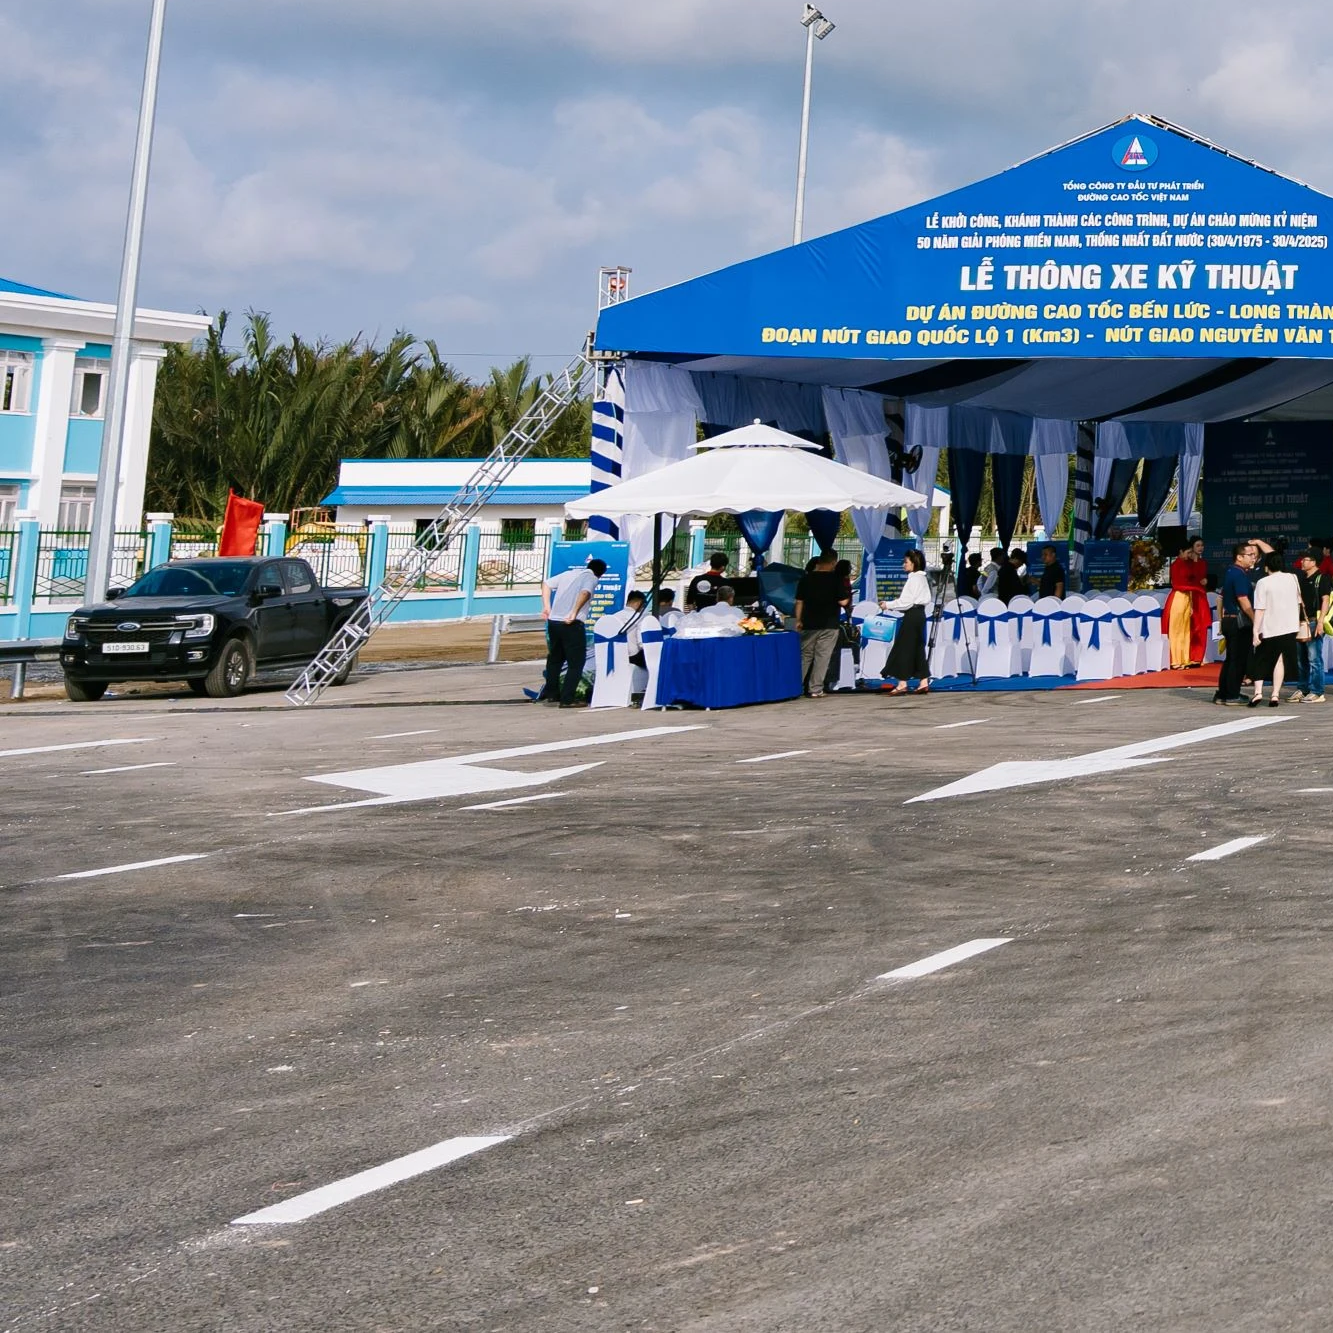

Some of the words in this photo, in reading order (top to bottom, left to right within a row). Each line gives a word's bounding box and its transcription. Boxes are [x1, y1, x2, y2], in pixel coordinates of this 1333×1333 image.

[1063, 180, 1086, 190] TỔNG
[1128, 180, 1145, 189] ĐẦU
[1159, 181, 1180, 189] PHÁT
[1183, 180, 1204, 189] TRIỂN
[1078, 193, 1108, 201] ĐƯỜNG
[1135, 192, 1148, 200] TỐC
[1151, 193, 1167, 202] VIỆT
[926, 212, 939, 228] LỄ
[942, 213, 967, 228] KHỞI
[970, 214, 1001, 228] CÔNG,
[1005, 213, 1040, 227] KHÁNH
[1043, 213, 1078, 227] THÀNH
[1081, 213, 1101, 226] CÁC
[1105, 213, 1133, 226] CÔNG
[1136, 213, 1170, 227] TRÌNH,
[1173, 214, 1189, 229] DỰ
[1190, 213, 1205, 226] ÁN
[1208, 213, 1236, 226] CHÀO
[1239, 213, 1271, 227] MỪNG
[1274, 213, 1287, 226] KỶ
[1290, 213, 1317, 229] NIỆM
[917, 237, 930, 248] 50
[933, 235, 958, 248] NĂM
[961, 232, 982, 248] GIẢI
[985, 234, 1021, 247] PHÓNG
[1054, 235, 1082, 248] NAM,
[1085, 232, 1119, 247] THỐNG
[1122, 232, 1150, 246] NHẤT
[1152, 232, 1172, 246] ĐẤT
[1175, 232, 1204, 246] NƯỚC
[1207, 235, 1262, 248] (30/4/1975
[1273, 235, 1327, 249] 30/4/2025)
[961, 257, 994, 290] LỄ
[1004, 260, 1101, 289] THÔNG
[1111, 265, 1148, 289] XE
[1158, 260, 1196, 289] KỸ
[1205, 260, 1298, 295] THUẬT
[906, 305, 935, 321] DỰ
[938, 303, 966, 320] ÁN
[971, 302, 1037, 319] ĐƯỜNG
[1044, 304, 1081, 319] CAO
[1088, 302, 1123, 318] TỐC
[1129, 302, 1168, 318] BẾN
[1174, 302, 1210, 318] LỨC
[1230, 305, 1280, 319] LONG
[762, 328, 816, 345] ĐOẠN
[822, 327, 861, 343] NÚT
[866, 330, 911, 344] GIAO
[917, 327, 969, 345] QUỐC
[975, 327, 998, 345] LỘ
[1006, 329, 1013, 342] 1
[1023, 328, 1079, 344] (Km3)
[1106, 327, 1143, 342] NÚT
[1149, 328, 1194, 342] GIAO
[1200, 327, 1278, 342] NGUYỄN
[1284, 327, 1322, 343] VĂN
